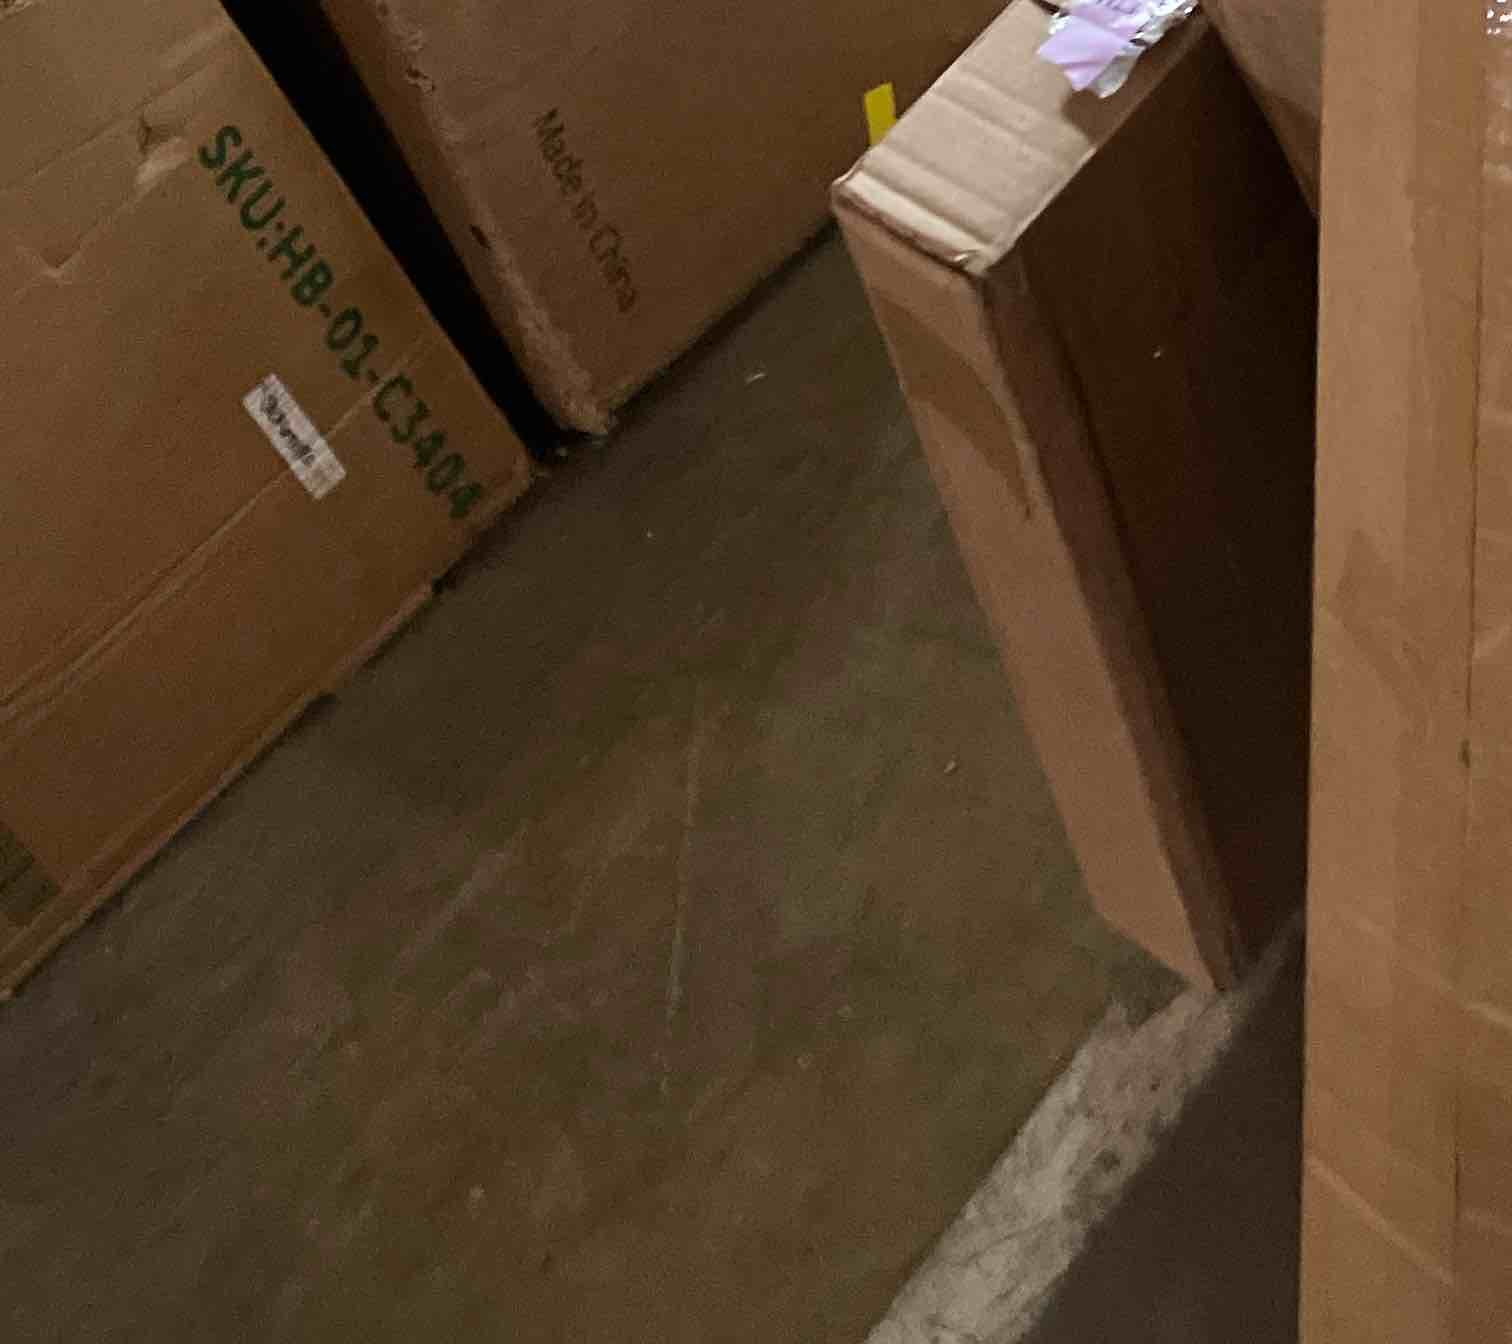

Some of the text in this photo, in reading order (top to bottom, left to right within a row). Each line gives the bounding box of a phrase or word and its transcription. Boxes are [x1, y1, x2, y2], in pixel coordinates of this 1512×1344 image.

[198, 124, 486, 518] SKU:HB-01-C3404
[533, 107, 580, 193] Made
[587, 227, 637, 316] China
